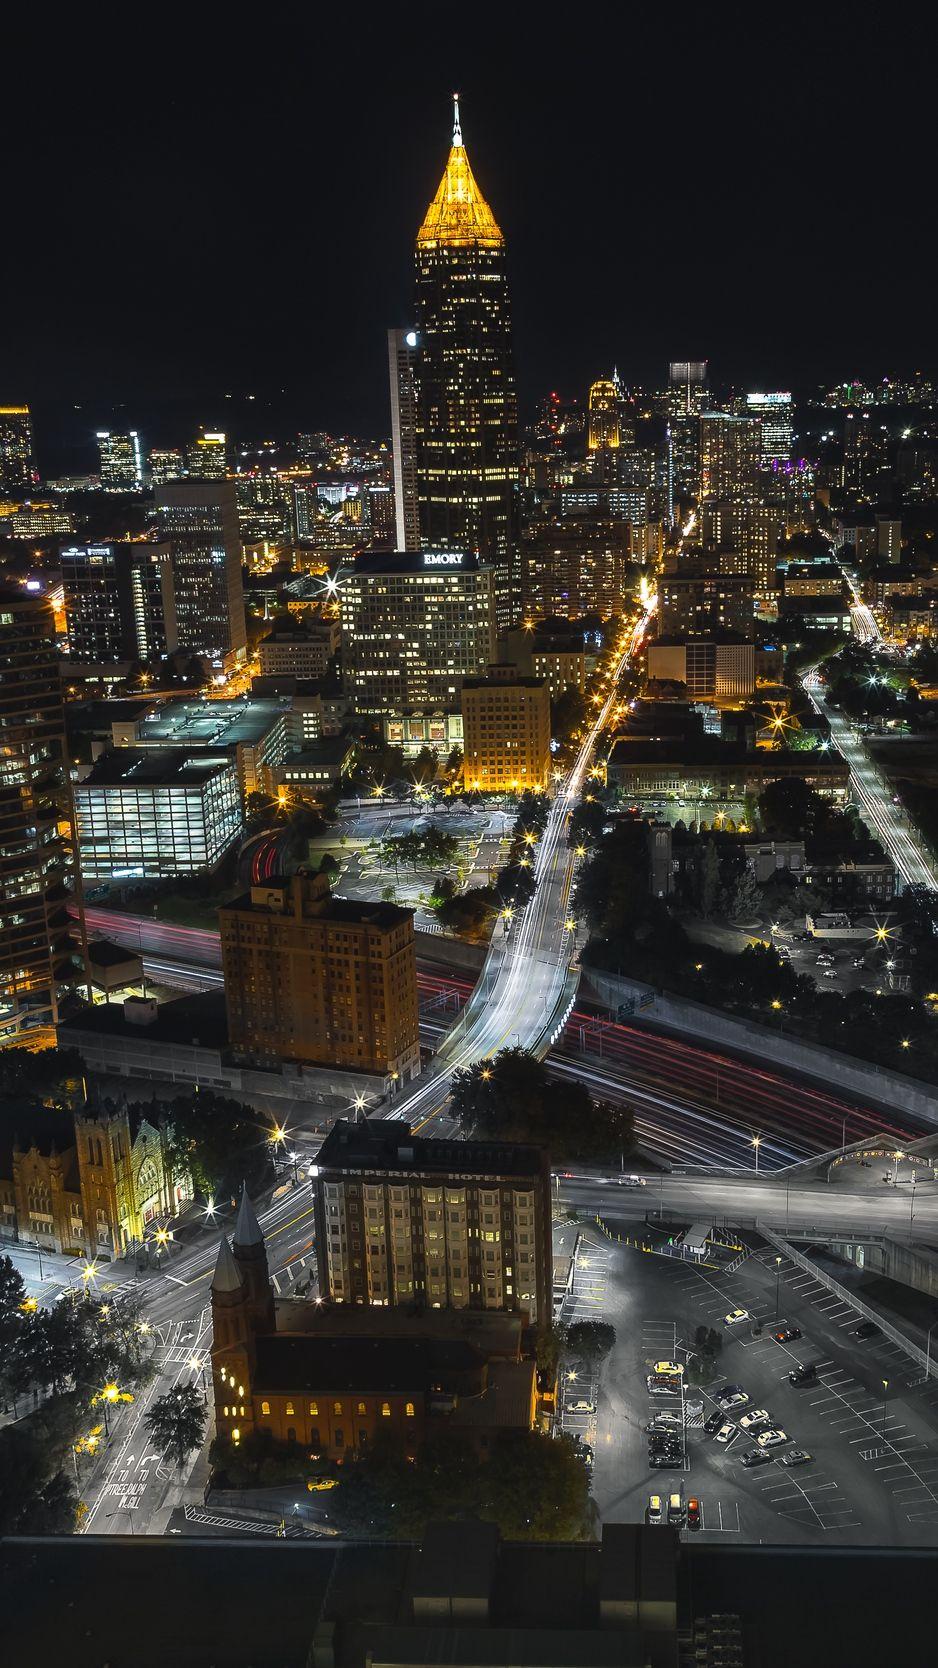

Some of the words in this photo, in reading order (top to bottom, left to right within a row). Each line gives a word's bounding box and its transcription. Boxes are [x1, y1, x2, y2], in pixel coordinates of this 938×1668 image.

[424, 554, 463, 564] EMORY
[342, 1169, 430, 1178] IMPERIAL
[448, 1173, 506, 1182] HOTEL
[118, 1469, 130, 1482] TO
[138, 1469, 150, 1482] TO
